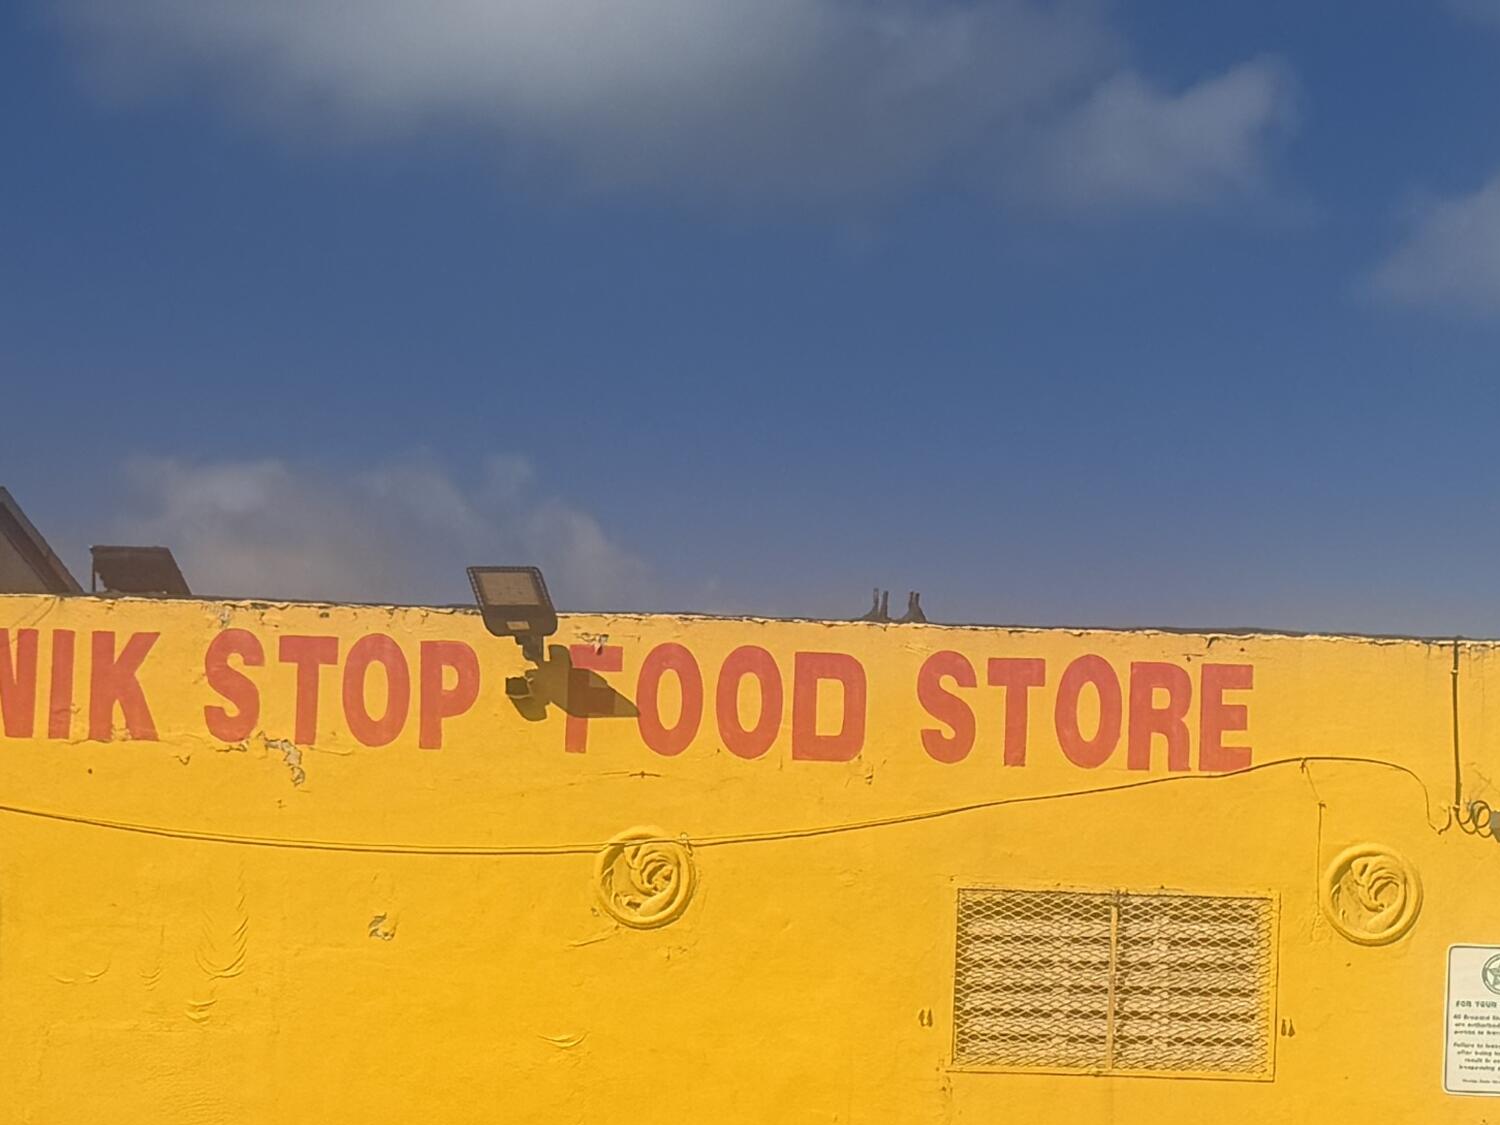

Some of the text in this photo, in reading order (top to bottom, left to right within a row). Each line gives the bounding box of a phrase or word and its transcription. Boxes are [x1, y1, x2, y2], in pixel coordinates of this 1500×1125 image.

[203, 628, 480, 750] STOP
[564, 642, 867, 761] FOOD
[917, 650, 1254, 772] STORE
[1456, 1000, 1472, 1008] FOR
